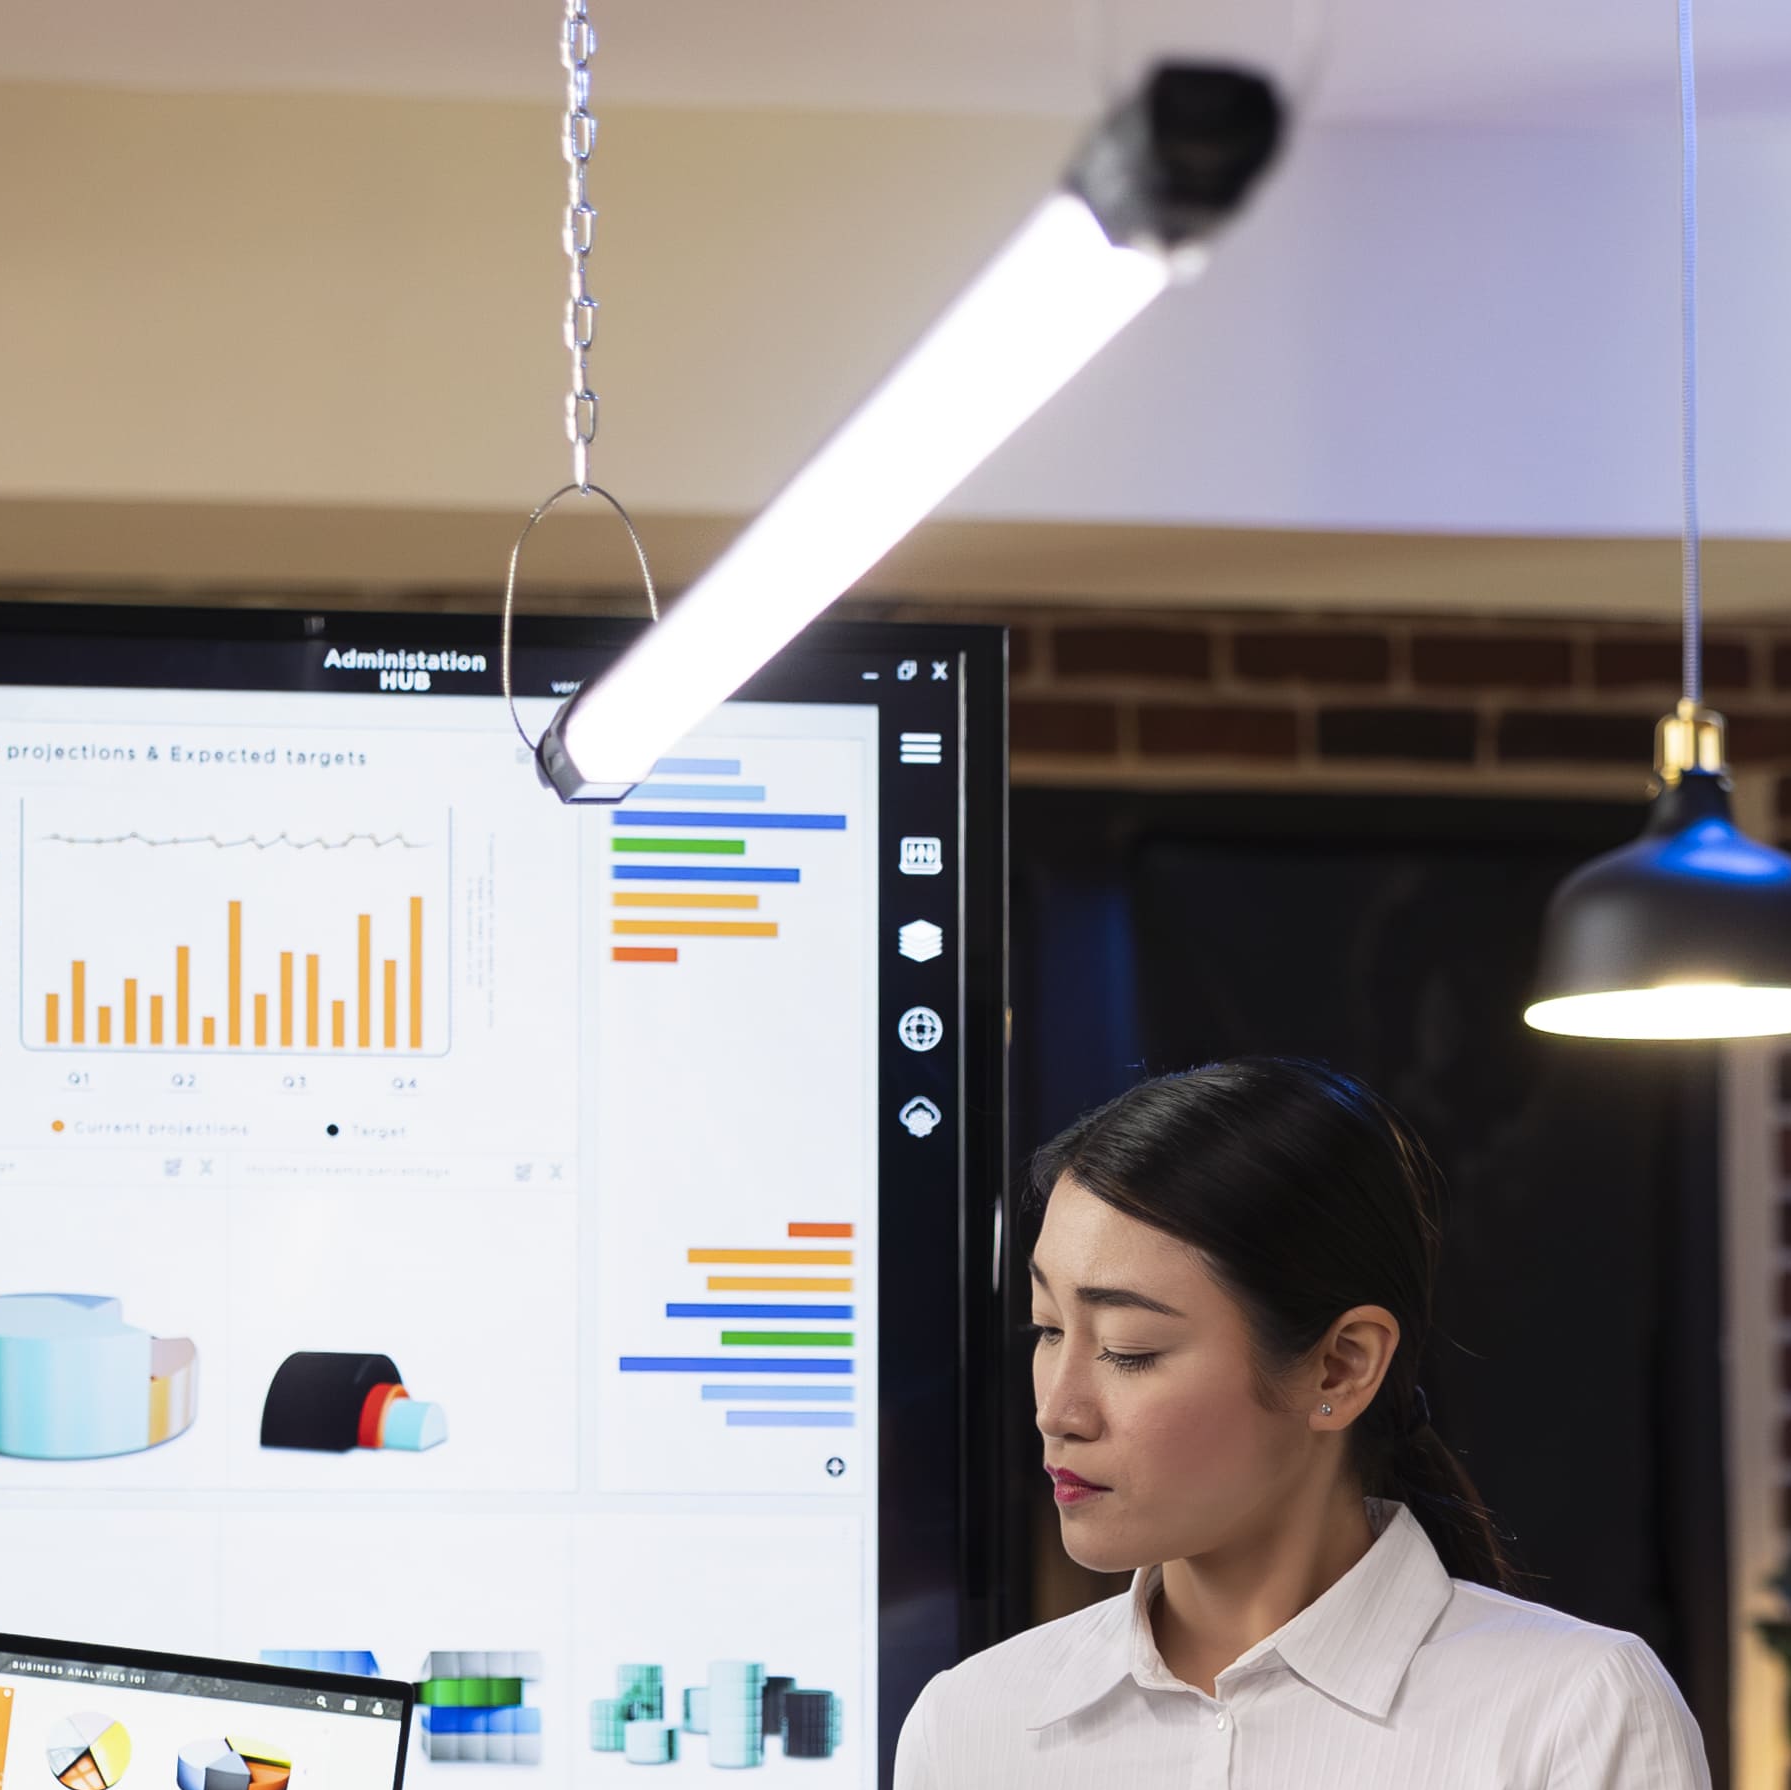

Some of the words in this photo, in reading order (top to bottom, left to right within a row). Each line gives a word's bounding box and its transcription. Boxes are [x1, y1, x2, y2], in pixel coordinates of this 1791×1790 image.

[324, 648, 486, 672] Administation
[380, 671, 431, 691] HUB
[7, 742, 136, 765] projections
[146, 746, 160, 761] &
[170, 745, 277, 767] Expected
[286, 747, 367, 768] targets
[170, 1072, 196, 1088] Q2
[73, 1119, 141, 1135] Current
[148, 1120, 249, 1139] projections
[353, 1122, 406, 1139] Target
[12, 1660, 63, 1675] BUSINESS
[67, 1667, 126, 1683] ANALYTICS
